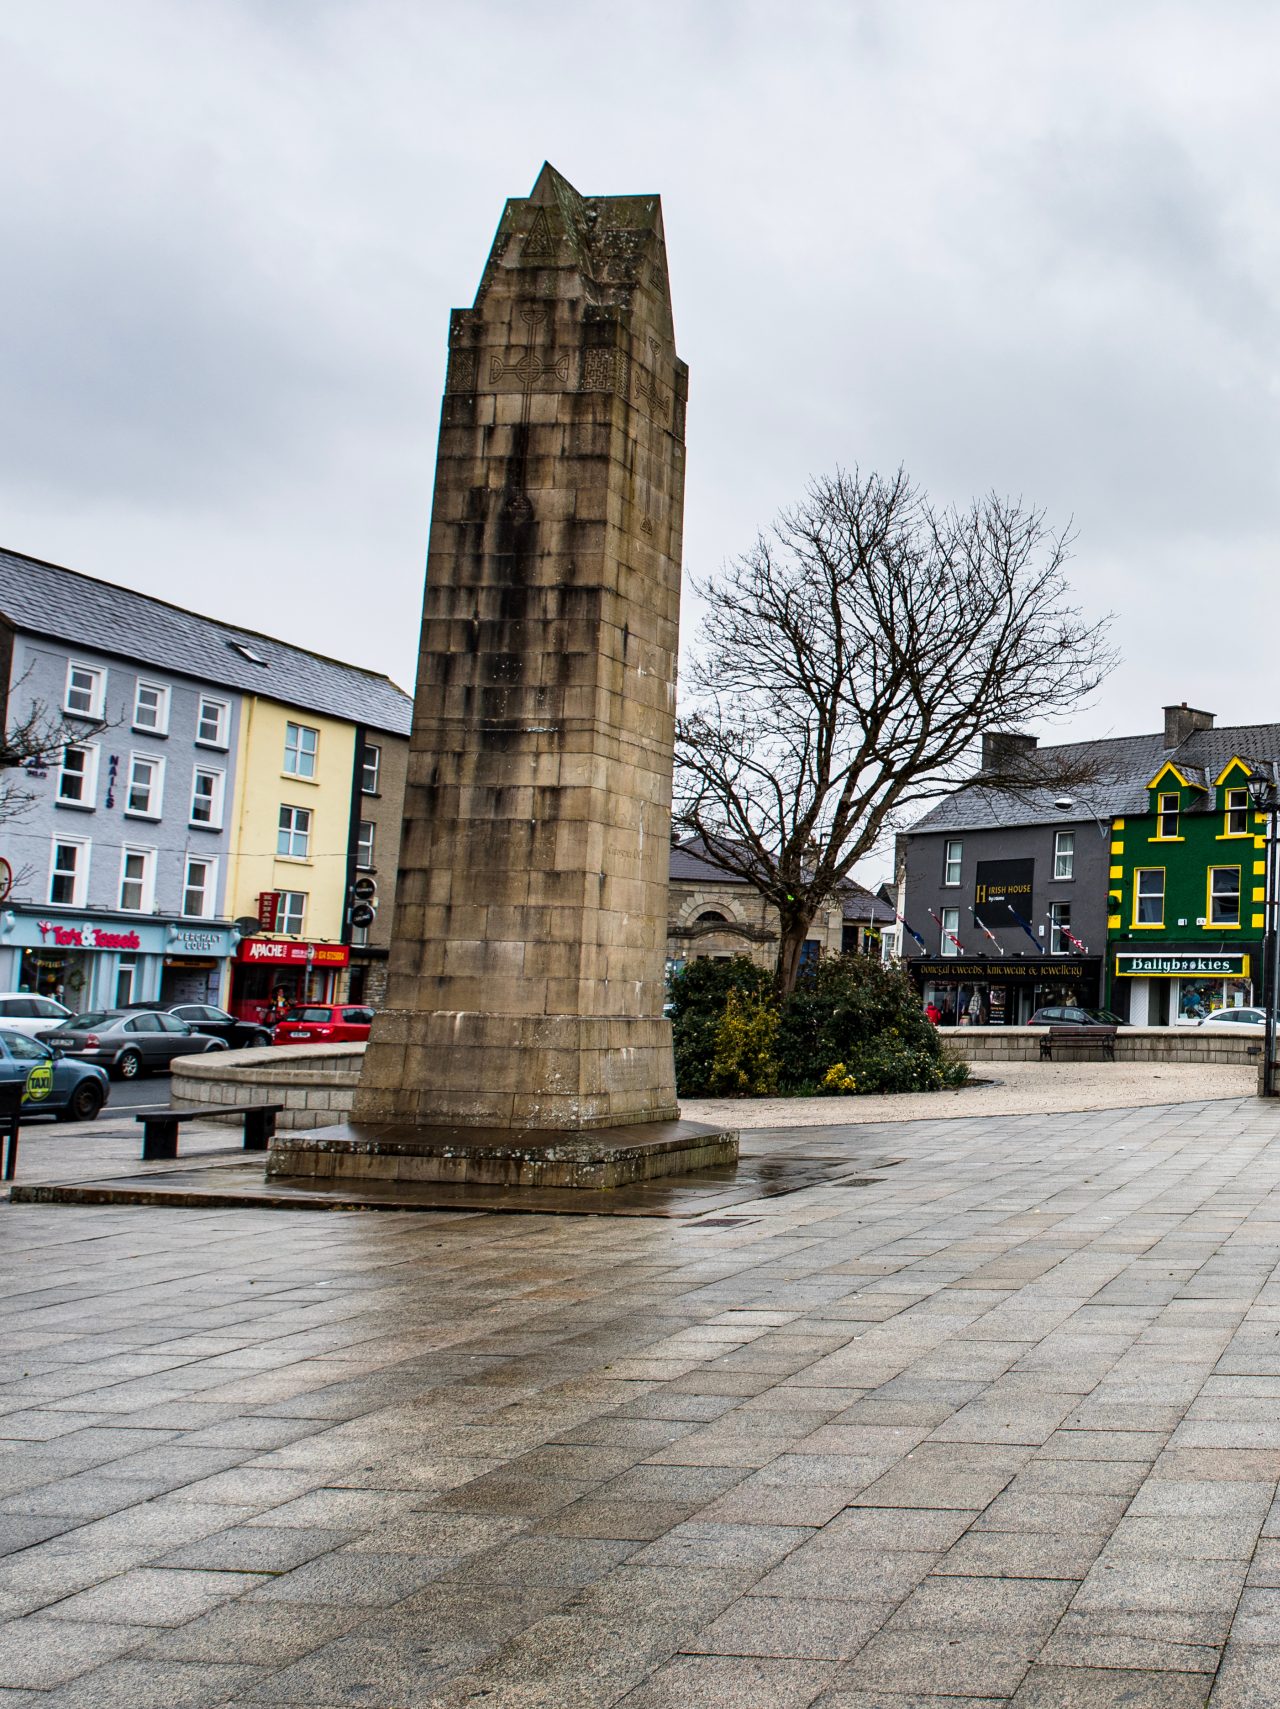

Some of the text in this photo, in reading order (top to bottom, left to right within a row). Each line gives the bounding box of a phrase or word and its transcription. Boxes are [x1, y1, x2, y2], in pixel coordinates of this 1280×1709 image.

[988, 884, 1031, 894] IRISH HOUSE
[53, 926, 82, 947] Tots
[92, 929, 141, 950] Tassels
[177, 932, 223, 943] MERCHANT
[185, 941, 213, 951] COURT
[249, 943, 284, 959] APACHE
[1028, 966, 1038, 975] &
[1131, 957, 1231, 974] Ballybookies
[31, 1076, 50, 1090] TAXI
